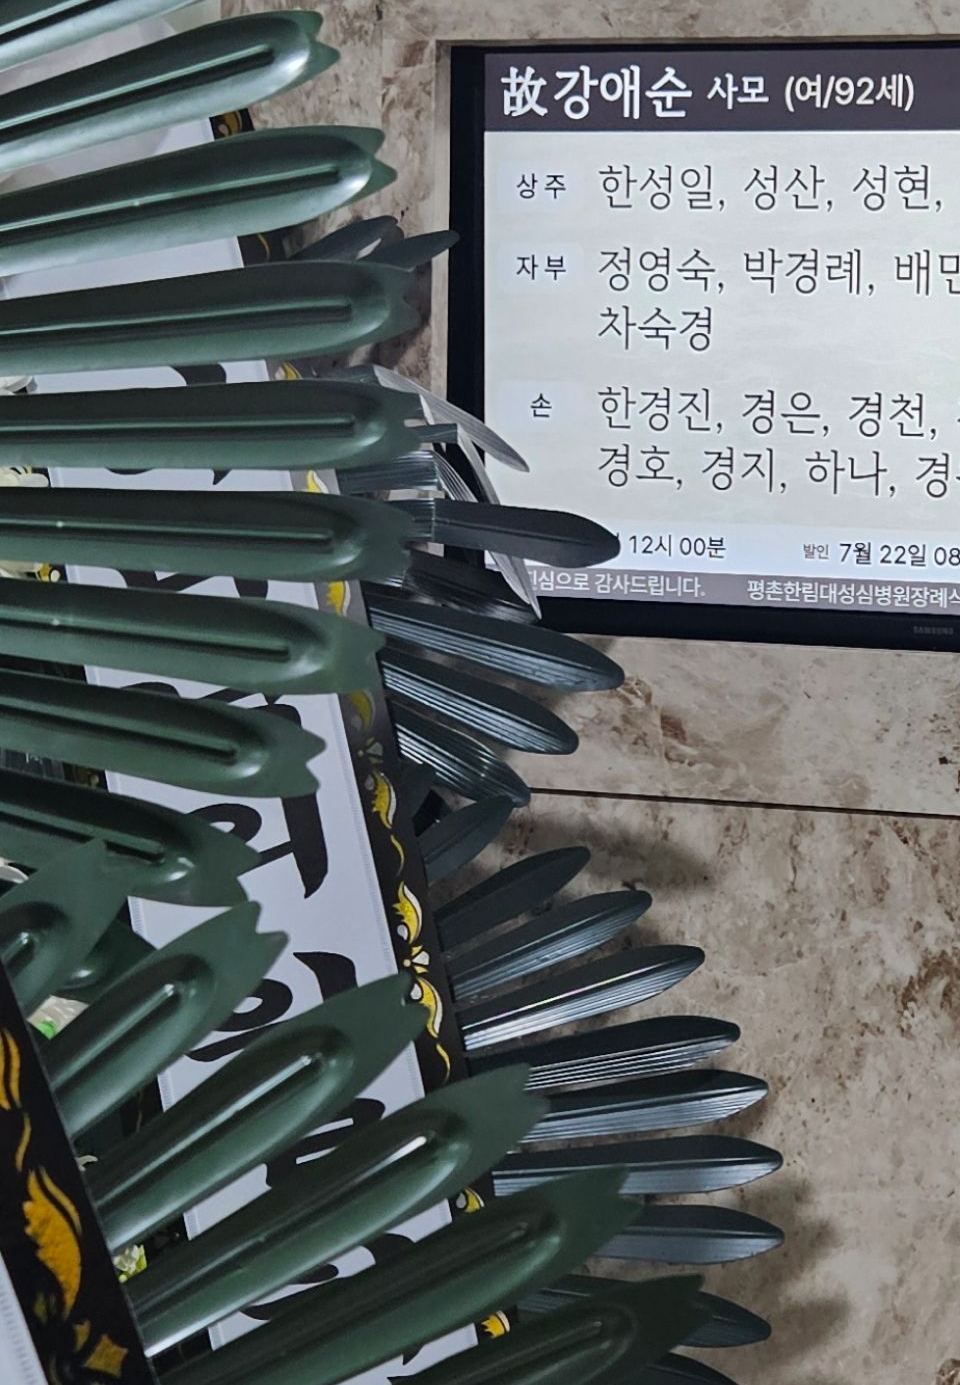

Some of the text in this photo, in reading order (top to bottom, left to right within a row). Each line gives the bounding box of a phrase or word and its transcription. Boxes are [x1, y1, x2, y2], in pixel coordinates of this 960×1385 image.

[706, 72, 770, 110] 사모
[784, 73, 915, 113] (여/92세)
[516, 172, 566, 200] 상주
[598, 164, 725, 212] 한성일,
[744, 164, 833, 212] 성산,
[852, 164, 942, 212] 성현,
[516, 254, 567, 281] 자부
[598, 246, 724, 294] 정영숙,
[743, 247, 874, 296] 박경례,
[598, 305, 712, 352] 차숙경
[530, 393, 553, 418] 손
[597, 385, 723, 434] 한경진,
[742, 389, 829, 437] 경은,
[848, 391, 937, 440] 경천,
[598, 443, 683, 490] 경호,
[701, 446, 787, 494] 경지,
[805, 449, 896, 497] 하나,
[628, 534, 726, 559] 12시 00분
[803, 543, 829, 560] 발인
[839, 541, 872, 565] 7월
[879, 543, 926, 567] 22일
[594, 573, 706, 598] 감사드립니다.
